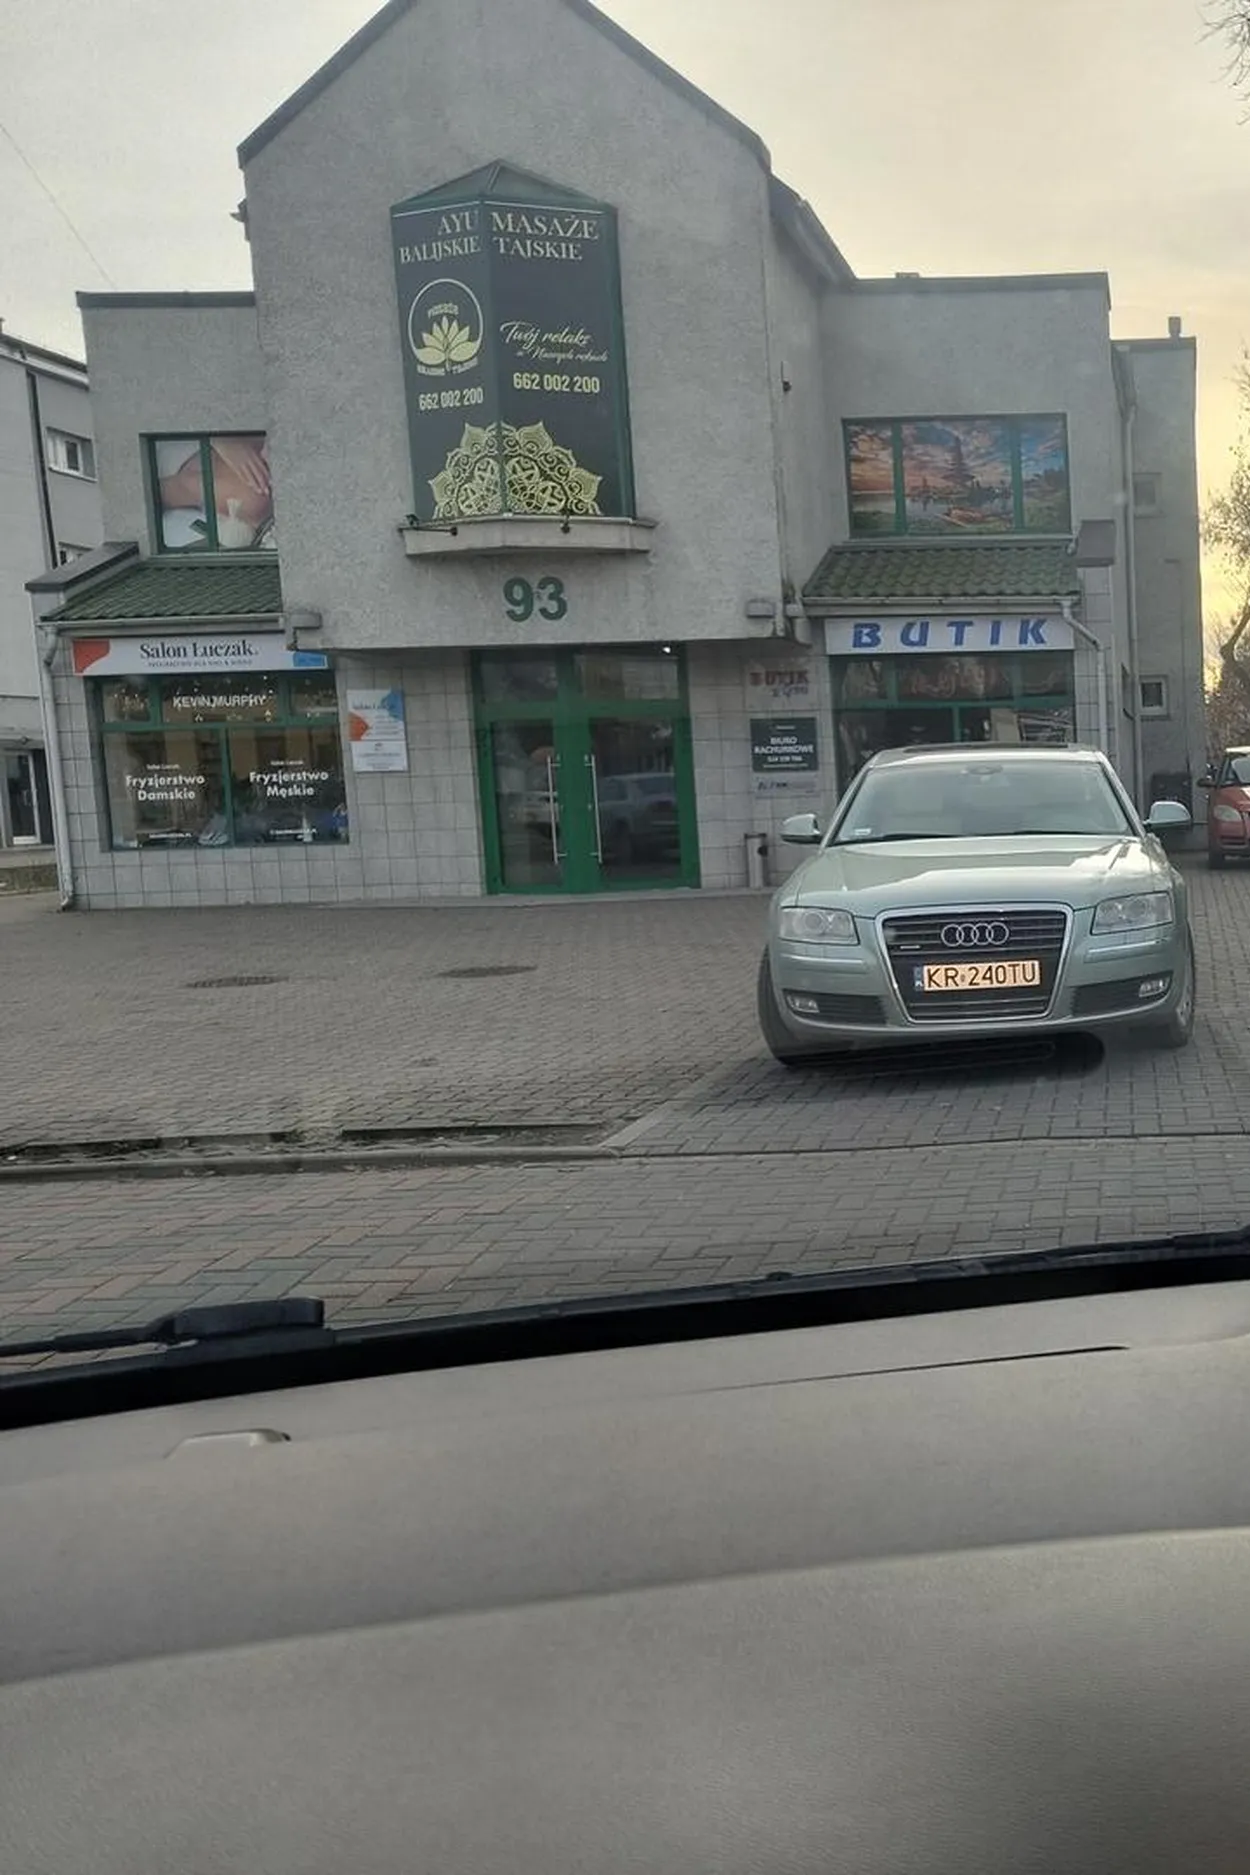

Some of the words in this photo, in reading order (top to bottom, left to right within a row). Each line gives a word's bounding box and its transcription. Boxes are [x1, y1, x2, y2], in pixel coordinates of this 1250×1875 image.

[437, 210, 479, 235] AYU
[400, 236, 482, 263] BALIJSKIE
[493, 236, 583, 261] TAJSKIE
[513, 372, 540, 389] 662
[543, 374, 570, 391] 002
[573, 376, 600, 393] 200
[462, 386, 484, 405] 200
[503, 576, 568, 622] 93
[852, 619, 1047, 648] BUTIK
[140, 641, 187, 659] Salon
[125, 773, 205, 790] Fryzjerstwo
[250, 770, 329, 786] Fryzjerstwo
[138, 788, 196, 801] Damskie
[267, 784, 315, 798] Męskie
[927, 966, 959, 988] KR
[968, 963, 1036, 986] 240TU
